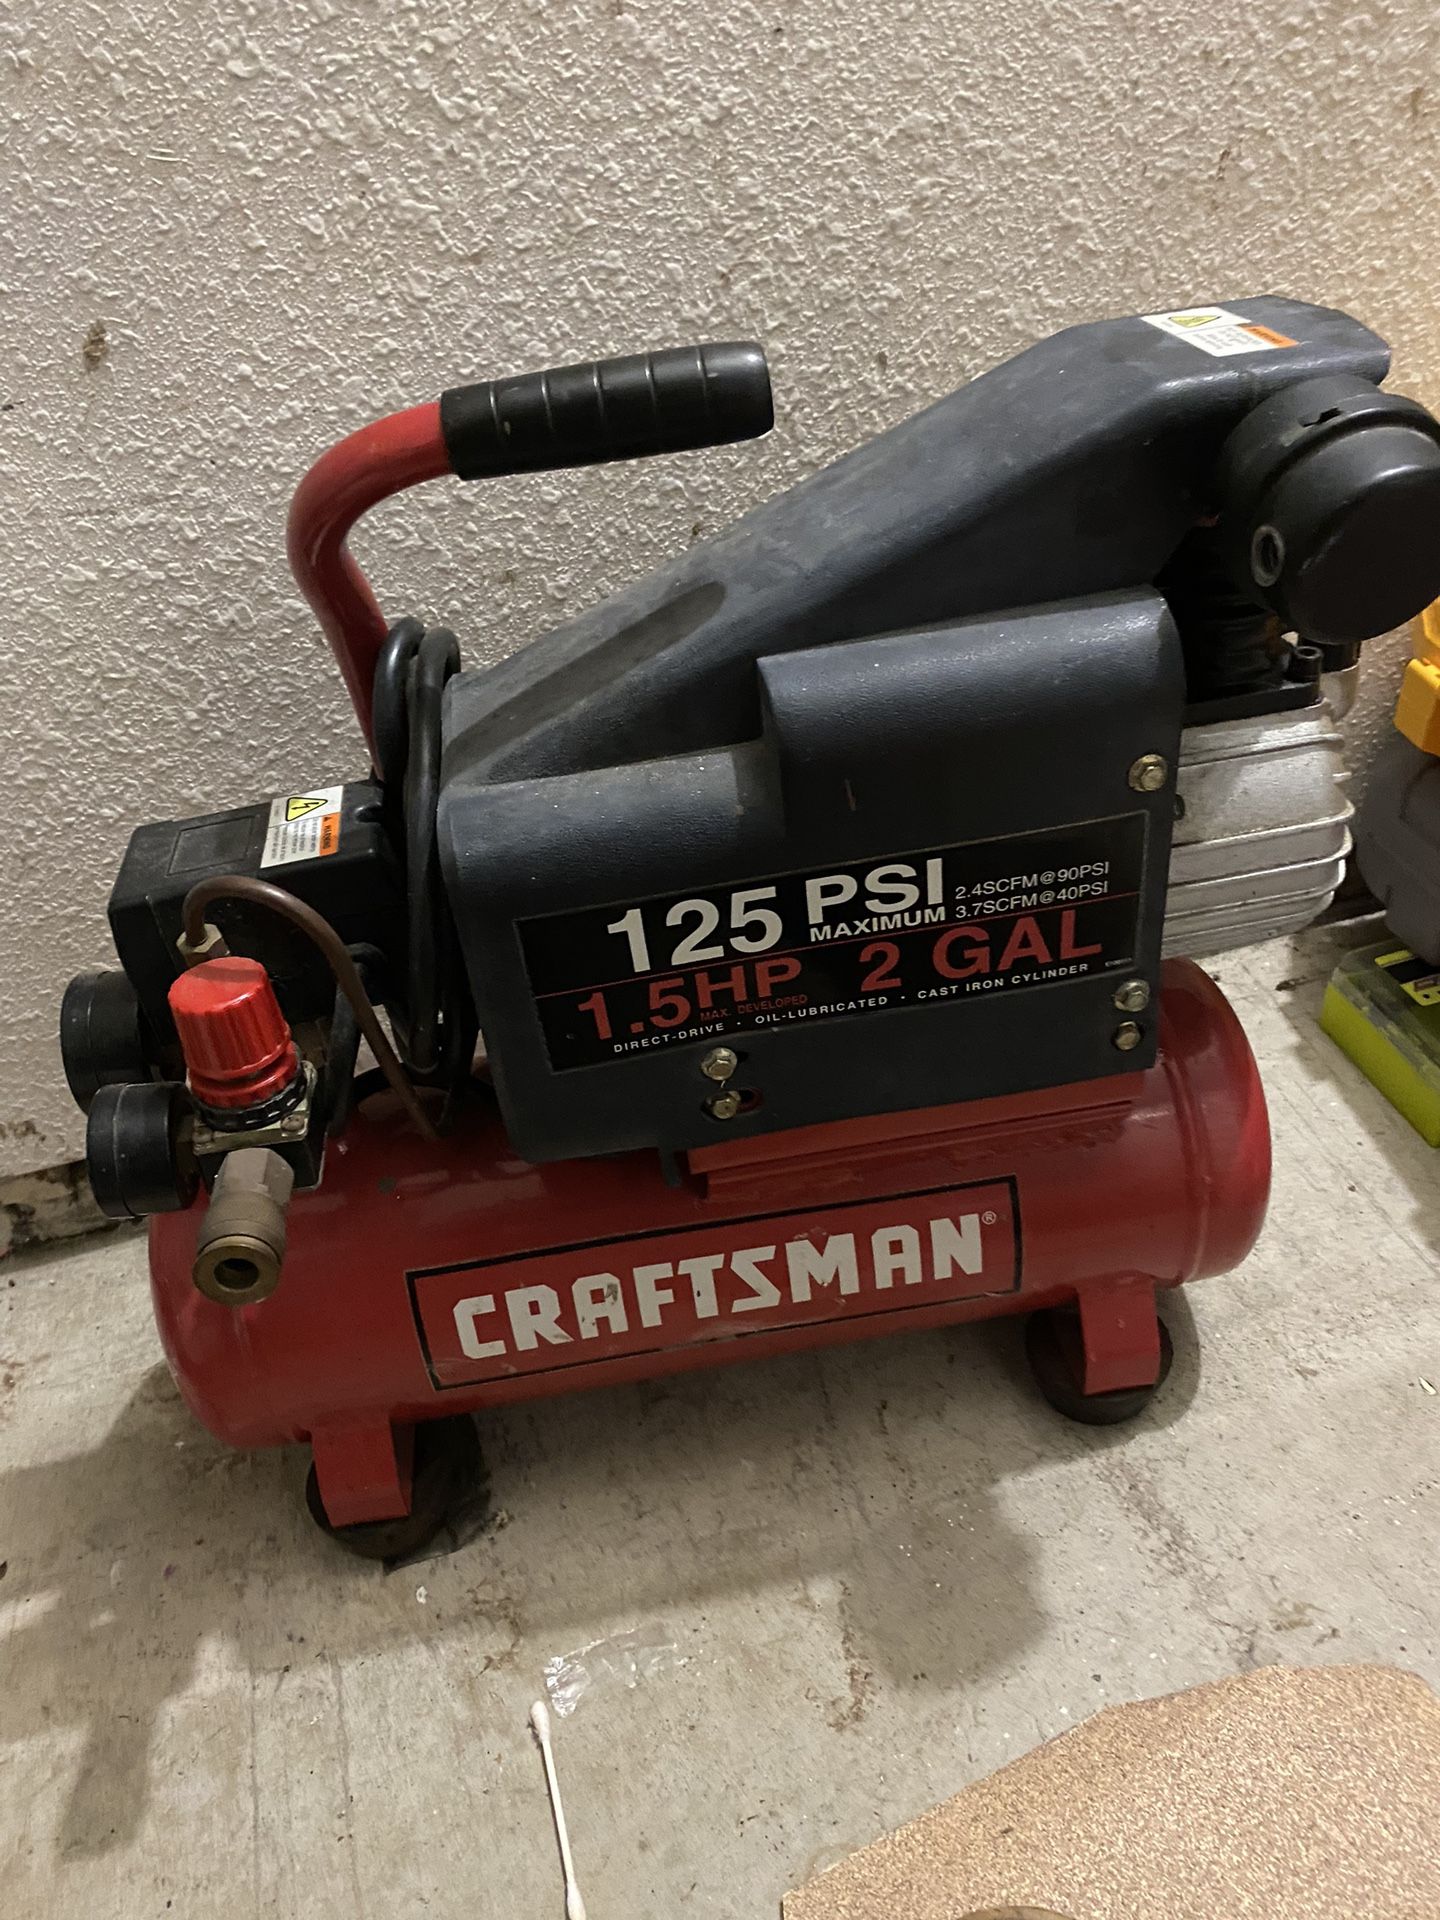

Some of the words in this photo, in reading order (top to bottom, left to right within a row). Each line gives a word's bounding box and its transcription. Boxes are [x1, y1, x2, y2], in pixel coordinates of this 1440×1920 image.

[954, 861, 1110, 900] 2.4SCFM@90PSI
[954, 880, 1109, 919] 3.7SCFM@40PSI
[606, 886, 784, 974] 125
[805, 858, 944, 925] PSI
[809, 907, 946, 943] MAXIMUM
[577, 957, 803, 1041] 1.5HP
[858, 941, 902, 992] 2
[932, 909, 1103, 979] GAL
[613, 1022, 726, 1054] DIRECT-DRIVE
[754, 996, 889, 1024] OIL-LUBRICATED
[917, 985, 960, 1000] CAST
[965, 978, 1004, 992] IRON
[1011, 963, 1089, 984] CYLINDER
[700, 1007, 732, 1022] MAX.
[737, 994, 809, 1014] DEVELOPED
